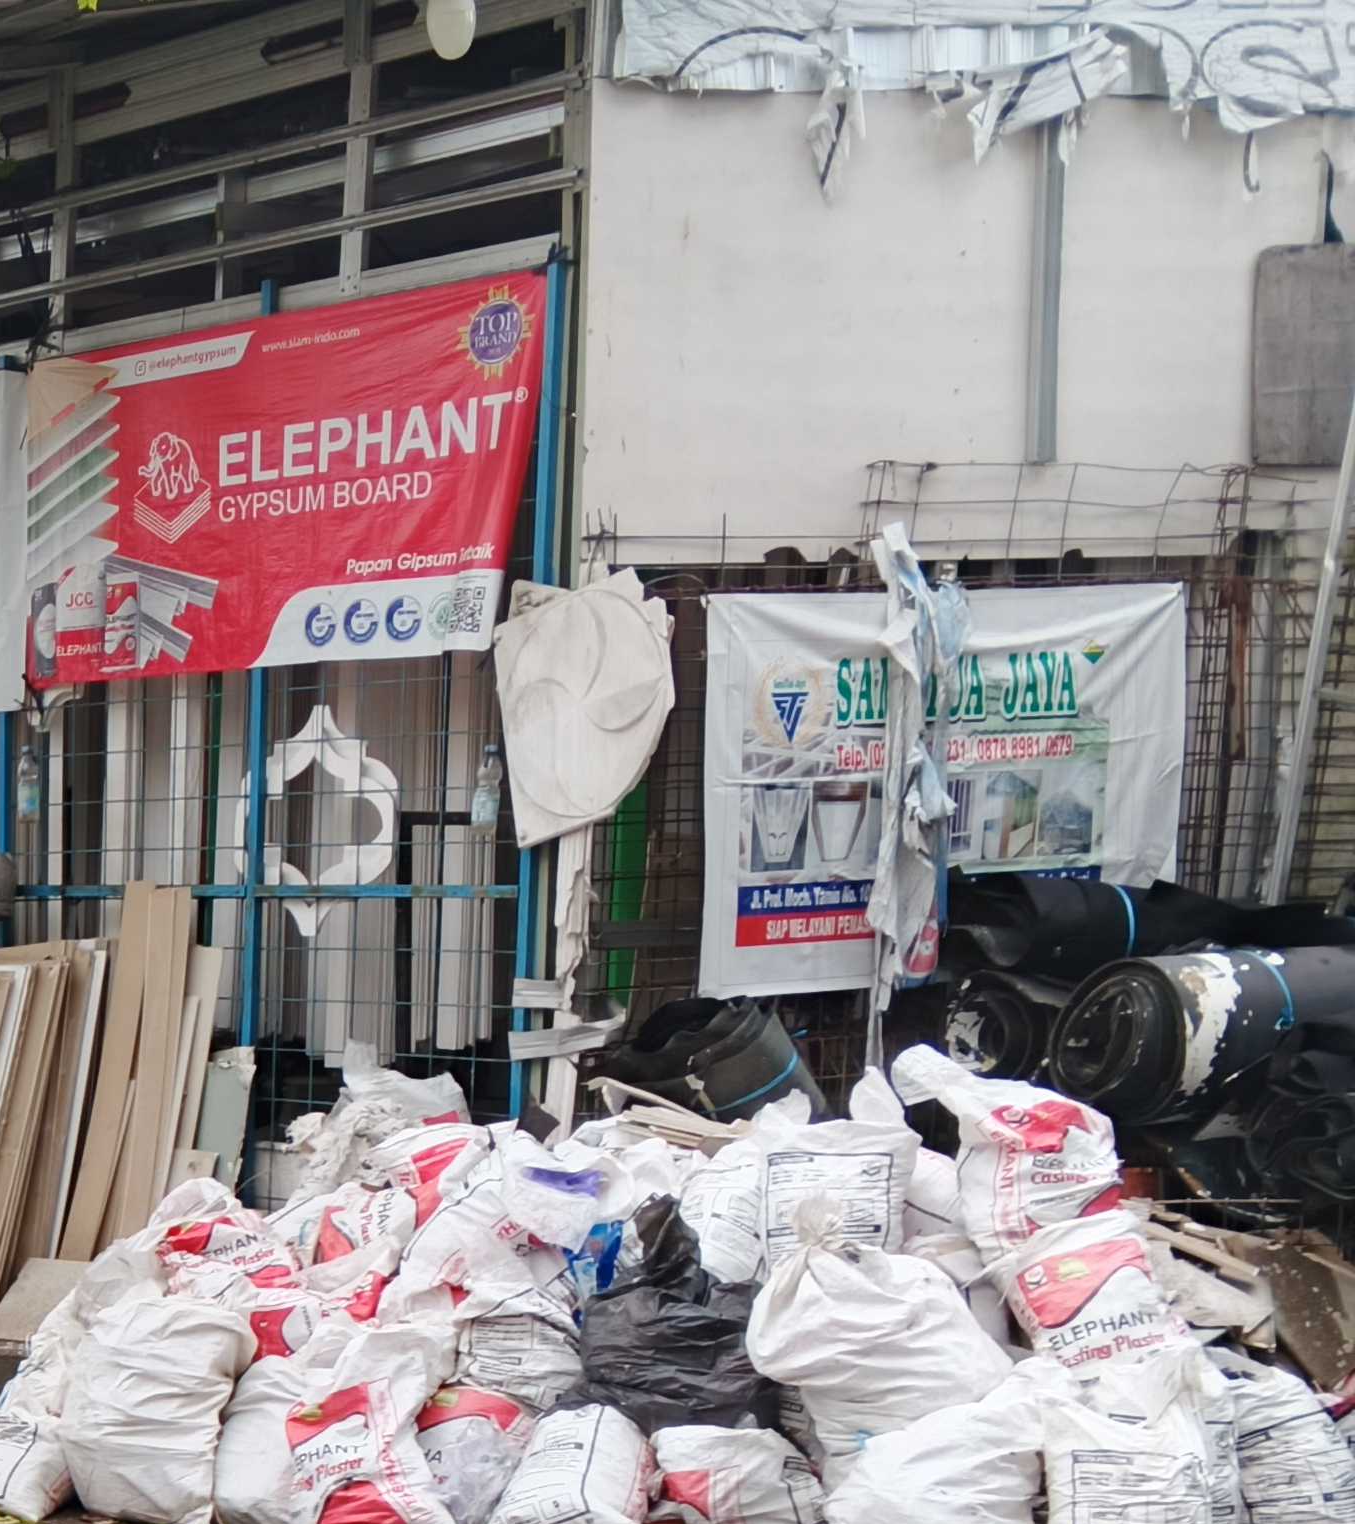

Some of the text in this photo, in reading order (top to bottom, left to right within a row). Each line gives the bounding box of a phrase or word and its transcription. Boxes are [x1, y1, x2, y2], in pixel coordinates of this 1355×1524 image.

[474, 311, 518, 336] TOP
[474, 331, 518, 348] BRAND
[218, 470, 433, 523] GYPSUM BOARD
[346, 558, 393, 576] Papan
[397, 550, 458, 572] Gipsum
[55, 642, 103, 657] ELEPHANT
[1002, 649, 1078, 718] JAYA
[1048, 1310, 1155, 1352] ELEPHANT
[314, 1456, 365, 1483] Plaster
